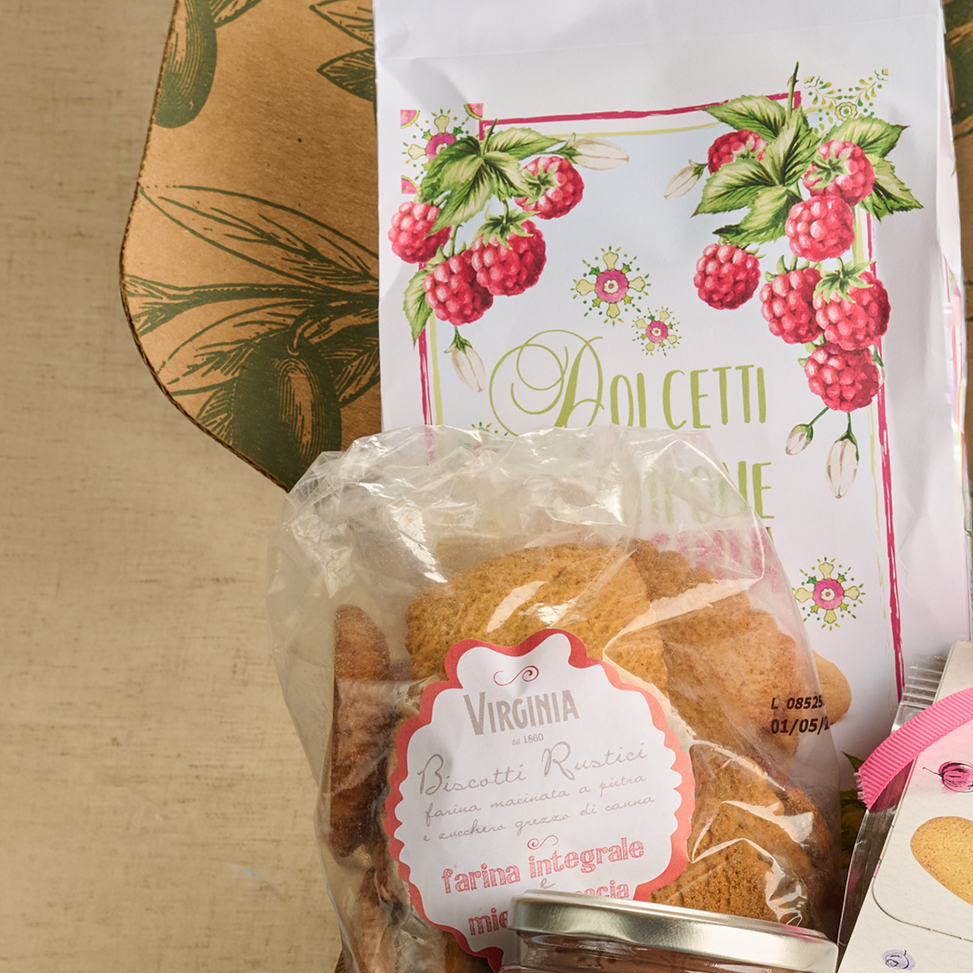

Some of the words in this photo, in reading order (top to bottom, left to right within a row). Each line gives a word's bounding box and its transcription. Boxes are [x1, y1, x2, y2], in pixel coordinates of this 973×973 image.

[463, 688, 580, 736] VIRGINIA
[523, 732, 544, 745] 1860
[417, 753, 527, 796] Biscotti
[541, 740, 647, 781] Rustici
[423, 834, 431, 842] e
[438, 817, 506, 841] zucchero
[514, 813, 572, 837] grezzo
[579, 800, 598, 816] di
[604, 795, 655, 813] canna
[424, 801, 482, 828] farina
[489, 788, 570, 810] macinata
[578, 785, 592, 795] a
[599, 773, 647, 798] pietra
[441, 862, 521, 895] farina
[528, 836, 645, 879] integrale
[540, 877, 556, 889] e
